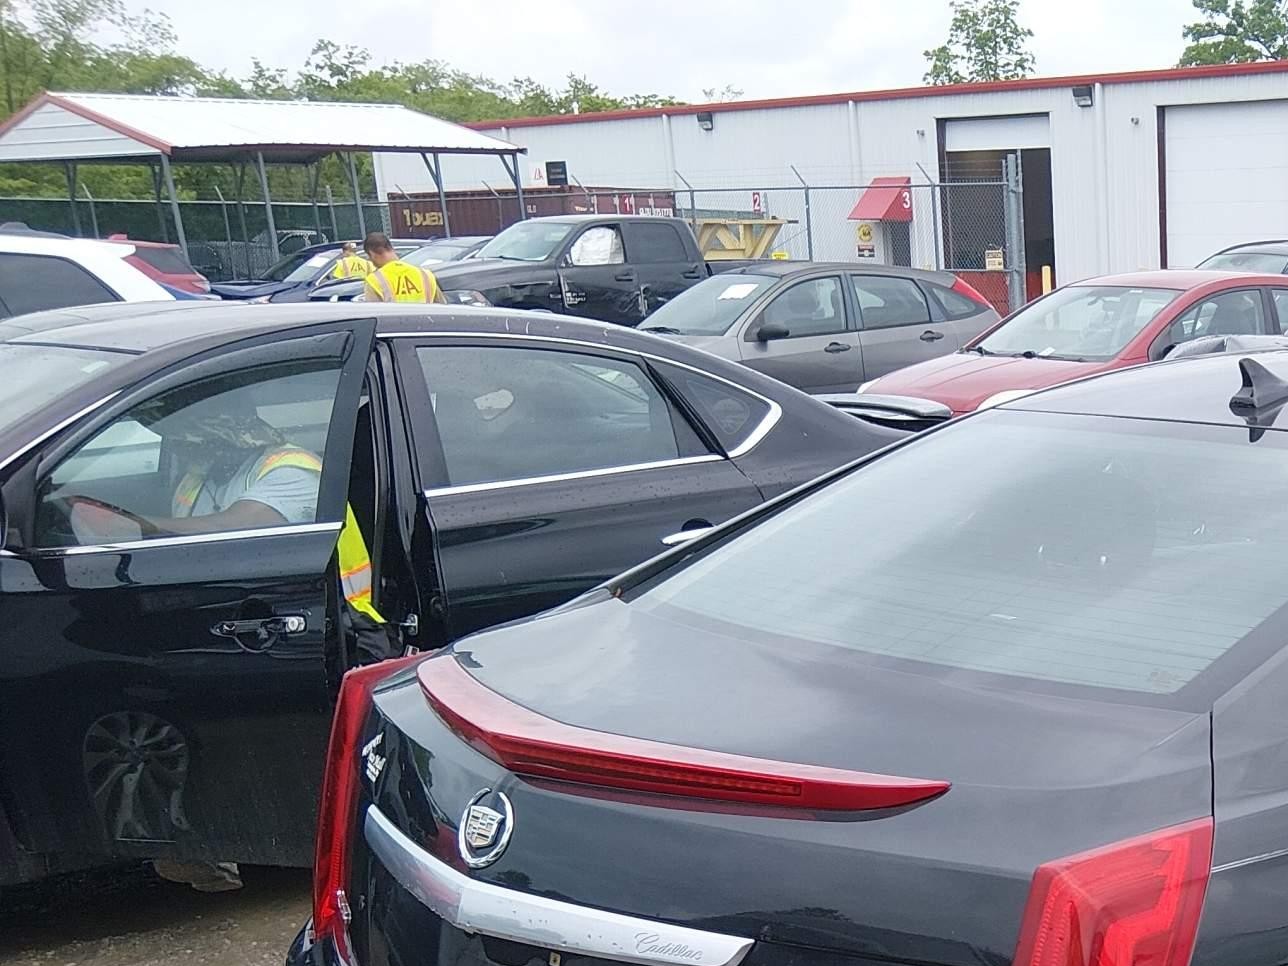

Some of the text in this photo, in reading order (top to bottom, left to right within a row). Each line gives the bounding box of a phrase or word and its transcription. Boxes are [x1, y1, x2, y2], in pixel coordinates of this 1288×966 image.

[624, 197, 630, 212] 1
[753, 194, 760, 210] 2
[902, 191, 911, 209] 3
[634, 932, 704, 961] Cadillac
